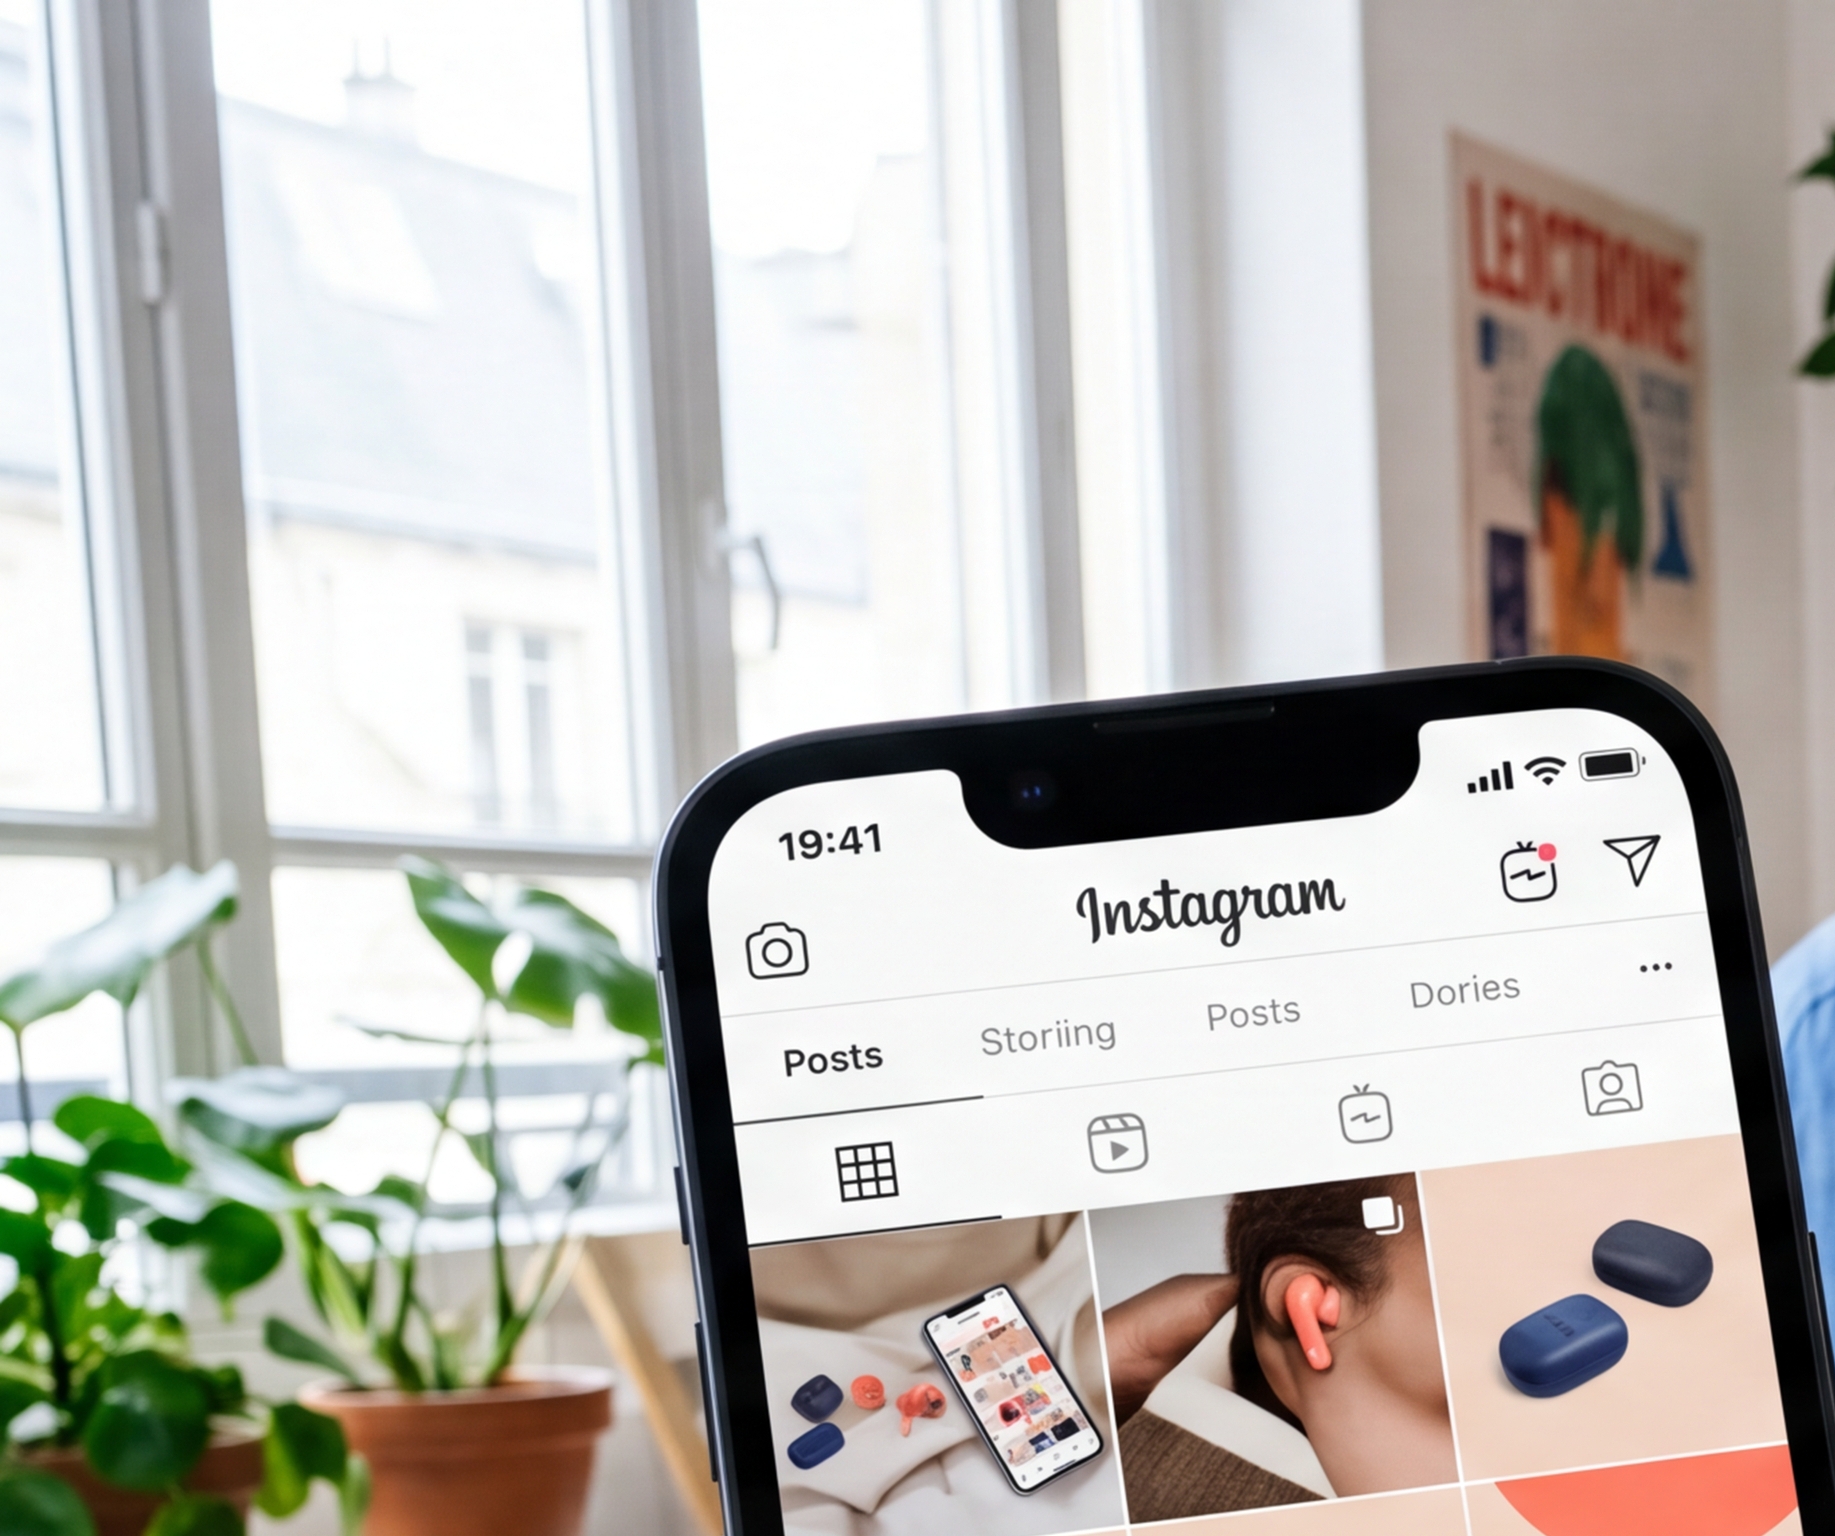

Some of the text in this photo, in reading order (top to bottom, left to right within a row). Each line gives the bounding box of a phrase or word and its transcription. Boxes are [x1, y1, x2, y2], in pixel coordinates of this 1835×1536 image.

[777, 822, 883, 862] 19:41
[1075, 871, 1347, 950] Instagram
[782, 971, 1521, 1078] Posts Storiing Posts Dories
